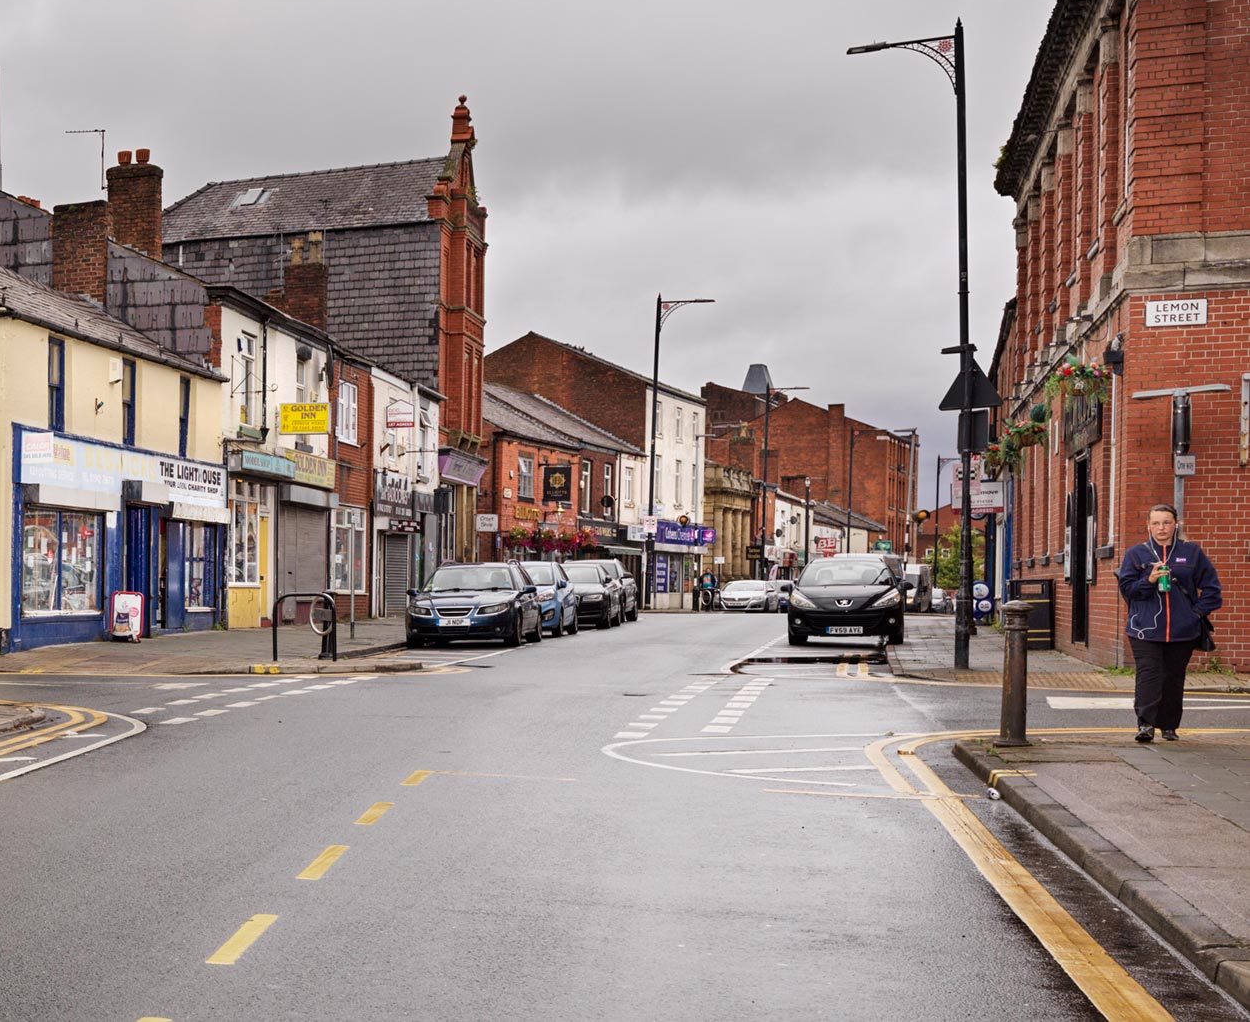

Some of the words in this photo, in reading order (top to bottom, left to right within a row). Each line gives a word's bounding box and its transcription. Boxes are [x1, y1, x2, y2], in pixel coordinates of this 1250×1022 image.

[1156, 302, 1199, 313] LEMON
[1154, 312, 1201, 324] STREET
[290, 404, 327, 412] GOLDEN
[300, 412, 317, 420] INN
[159, 461, 175, 478] THE
[177, 464, 222, 486] LIGHTHOUSE
[164, 479, 176, 489] YOUR
[187, 483, 206, 494] CHARITY
[207, 486, 219, 494] SHOP
